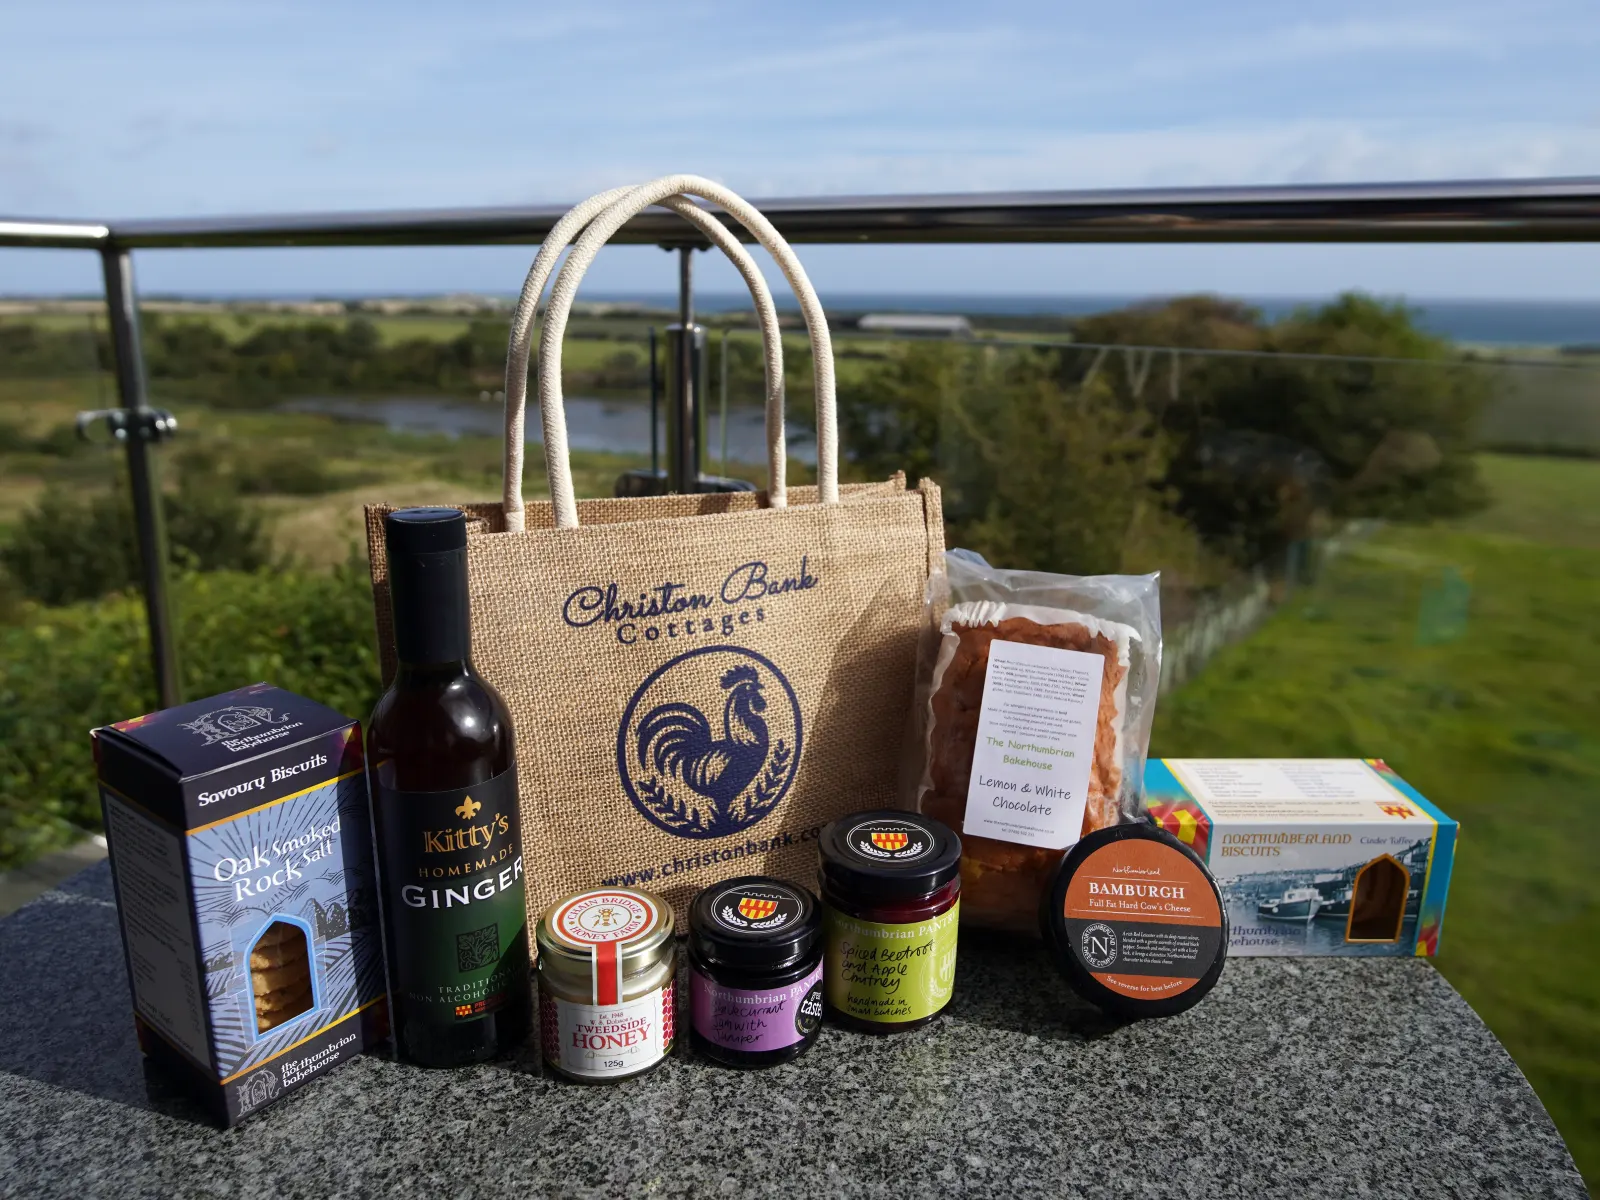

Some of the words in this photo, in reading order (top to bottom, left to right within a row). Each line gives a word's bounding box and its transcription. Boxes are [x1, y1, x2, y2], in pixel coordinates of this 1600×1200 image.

[563, 582, 714, 628] Christon
[720, 556, 819, 605] Bank
[616, 608, 766, 645] Cottages
[986, 736, 1004, 747] The
[1007, 739, 1075, 758] Northumbrian
[1003, 754, 1054, 770] Bakehouse
[197, 775, 267, 807] Savoury
[269, 752, 329, 784] Biscuits
[979, 774, 1017, 792] Lemon
[1020, 783, 1032, 793] &
[1035, 784, 1072, 800] White
[992, 796, 1052, 816] Chocolate
[421, 811, 510, 854] Kitty's
[1221, 832, 1353, 844] NORTHUMBERLAND
[1359, 836, 1388, 845] Cinder
[1389, 836, 1414, 845] Toffee
[213, 845, 271, 882] Oak
[271, 815, 342, 861] Smoked
[601, 824, 826, 888] www.christonbank.co
[1220, 846, 1282, 857] BISCUITS
[231, 858, 303, 902] Rock
[302, 839, 334, 868] Salt
[418, 842, 515, 879] HOMEMADE
[401, 853, 524, 910] GINGER
[1088, 882, 1185, 900] BAMBURGH
[567, 899, 598, 920] CHAIN
[601, 897, 642, 914] BRIDGE
[1089, 898, 1104, 908] Full
[1105, 899, 1117, 908] Fat
[1119, 900, 1138, 910] Hard
[1140, 901, 1163, 911] Cow's
[1164, 903, 1192, 913] Cheese
[569, 926, 609, 940] HONEY
[612, 920, 641, 938] FARM
[840, 941, 877, 961] Spiced
[880, 938, 935, 962] Beetroot
[1090, 936, 1109, 957] N
[841, 959, 867, 974] and
[872, 962, 908, 978] Apple
[438, 980, 507, 1004] ALCOHOLIC
[841, 968, 902, 995] Chutney
[1106, 975, 1117, 985] See
[1117, 981, 1139, 991] reverse
[1163, 979, 1183, 991] before
[703, 982, 788, 1005] Northumbrian
[847, 991, 896, 1007] handmade
[898, 997, 908, 1006] in
[611, 1011, 624, 1019] 1948
[847, 1004, 871, 1015] small
[873, 1005, 913, 1016] batches
[576, 1016, 647, 1034] TWEEDSIDE
[734, 1018, 768, 1032] with
[571, 1022, 652, 1051] HONEY
[281, 1060, 299, 1074] the
[282, 1033, 357, 1080] northumbrian
[603, 1060, 624, 1068] 125g
[282, 1051, 340, 1088] bakehouse
